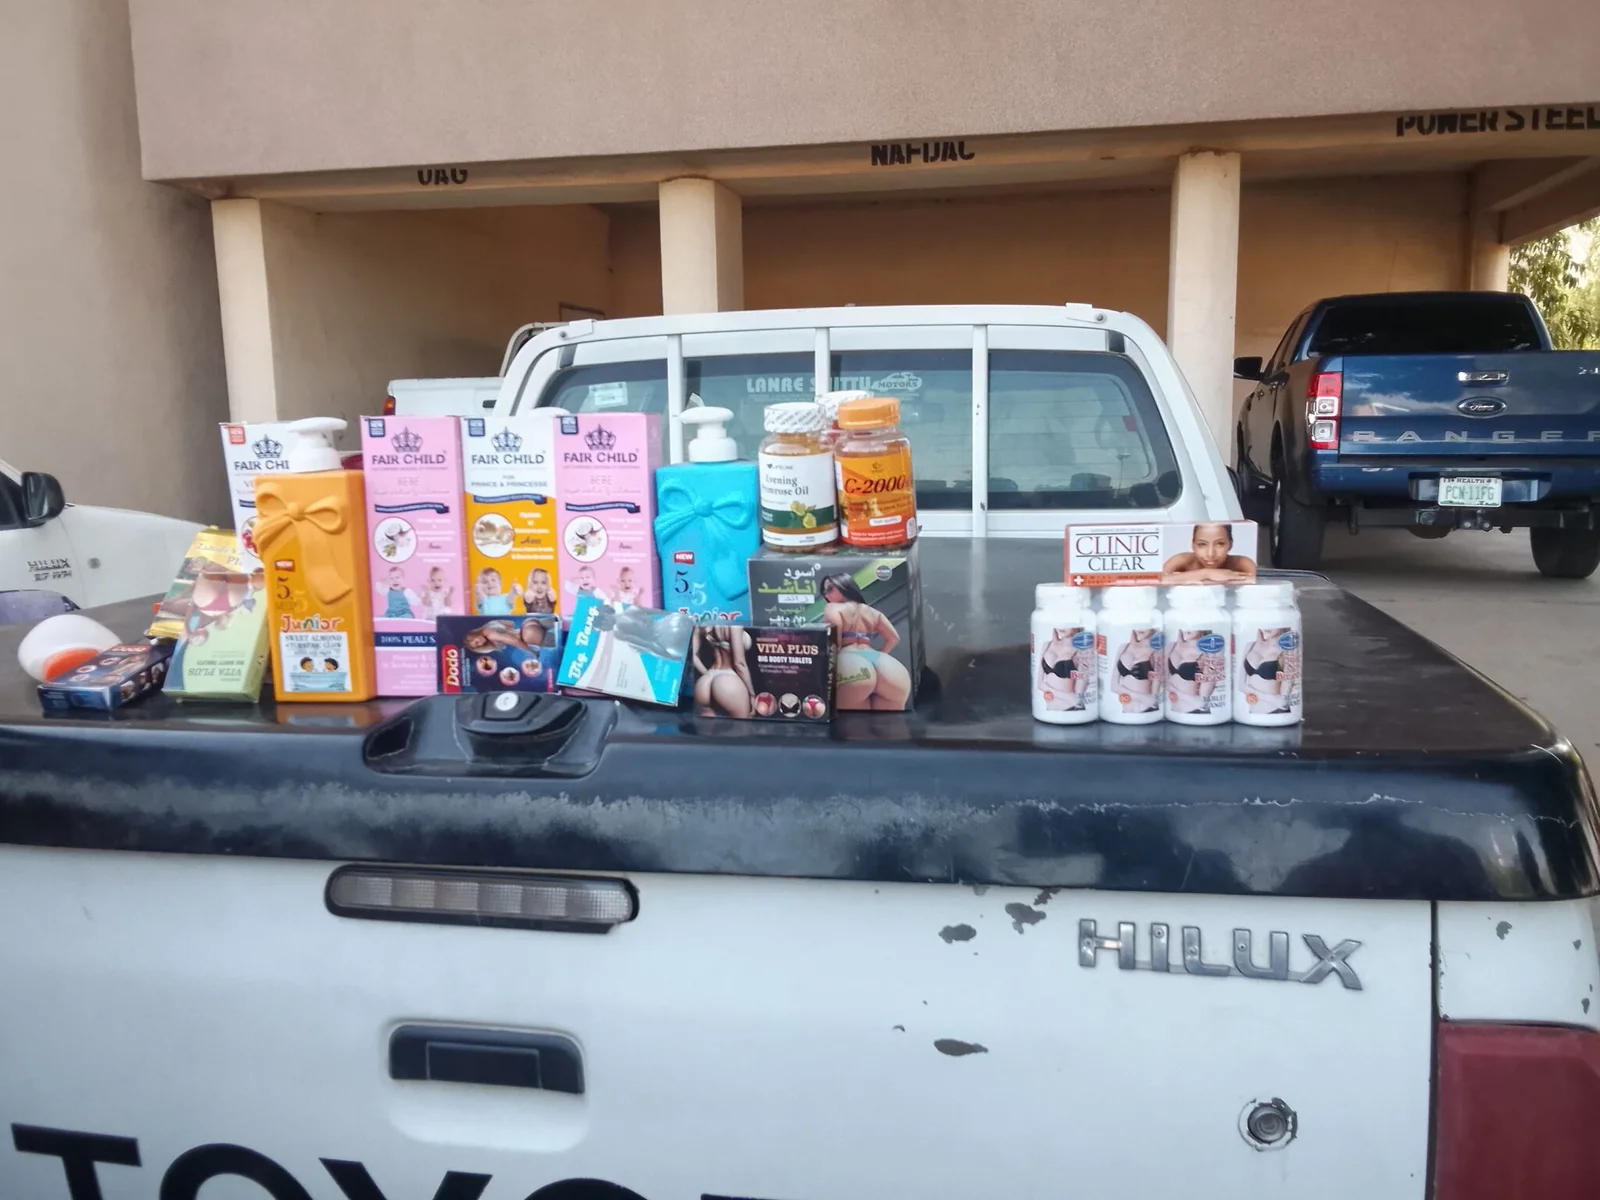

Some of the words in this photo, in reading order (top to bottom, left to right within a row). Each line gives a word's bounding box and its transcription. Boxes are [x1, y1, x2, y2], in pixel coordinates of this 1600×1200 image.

[747, 377, 804, 393] LANRE
[372, 455, 400, 465] FAIR
[403, 454, 446, 464] CHILD
[471, 454, 500, 464] FAIR
[503, 454, 545, 464] CHILD
[563, 453, 592, 463] FAIR
[596, 452, 638, 462] CHILD
[233, 461, 261, 470] FAIR
[265, 460, 290, 470] CHI
[795, 486, 809, 496] Oil
[844, 475, 906, 494] C-2000
[1075, 535, 1160, 555] CLINIC
[1088, 556, 1146, 571] CLEAR
[281, 614, 342, 633] Junior
[575, 605, 600, 647] Bang
[756, 643, 785, 654] VITA
[787, 644, 819, 656] PLUS
[567, 652, 588, 680] Big
[757, 655, 768, 663] BIG
[788, 657, 813, 665] TABLETS
[188, 668, 215, 676] PLUS
[219, 668, 242, 676] VITA
[446, 648, 460, 687] Dodo
[1079, 918, 1363, 991] HILUX
